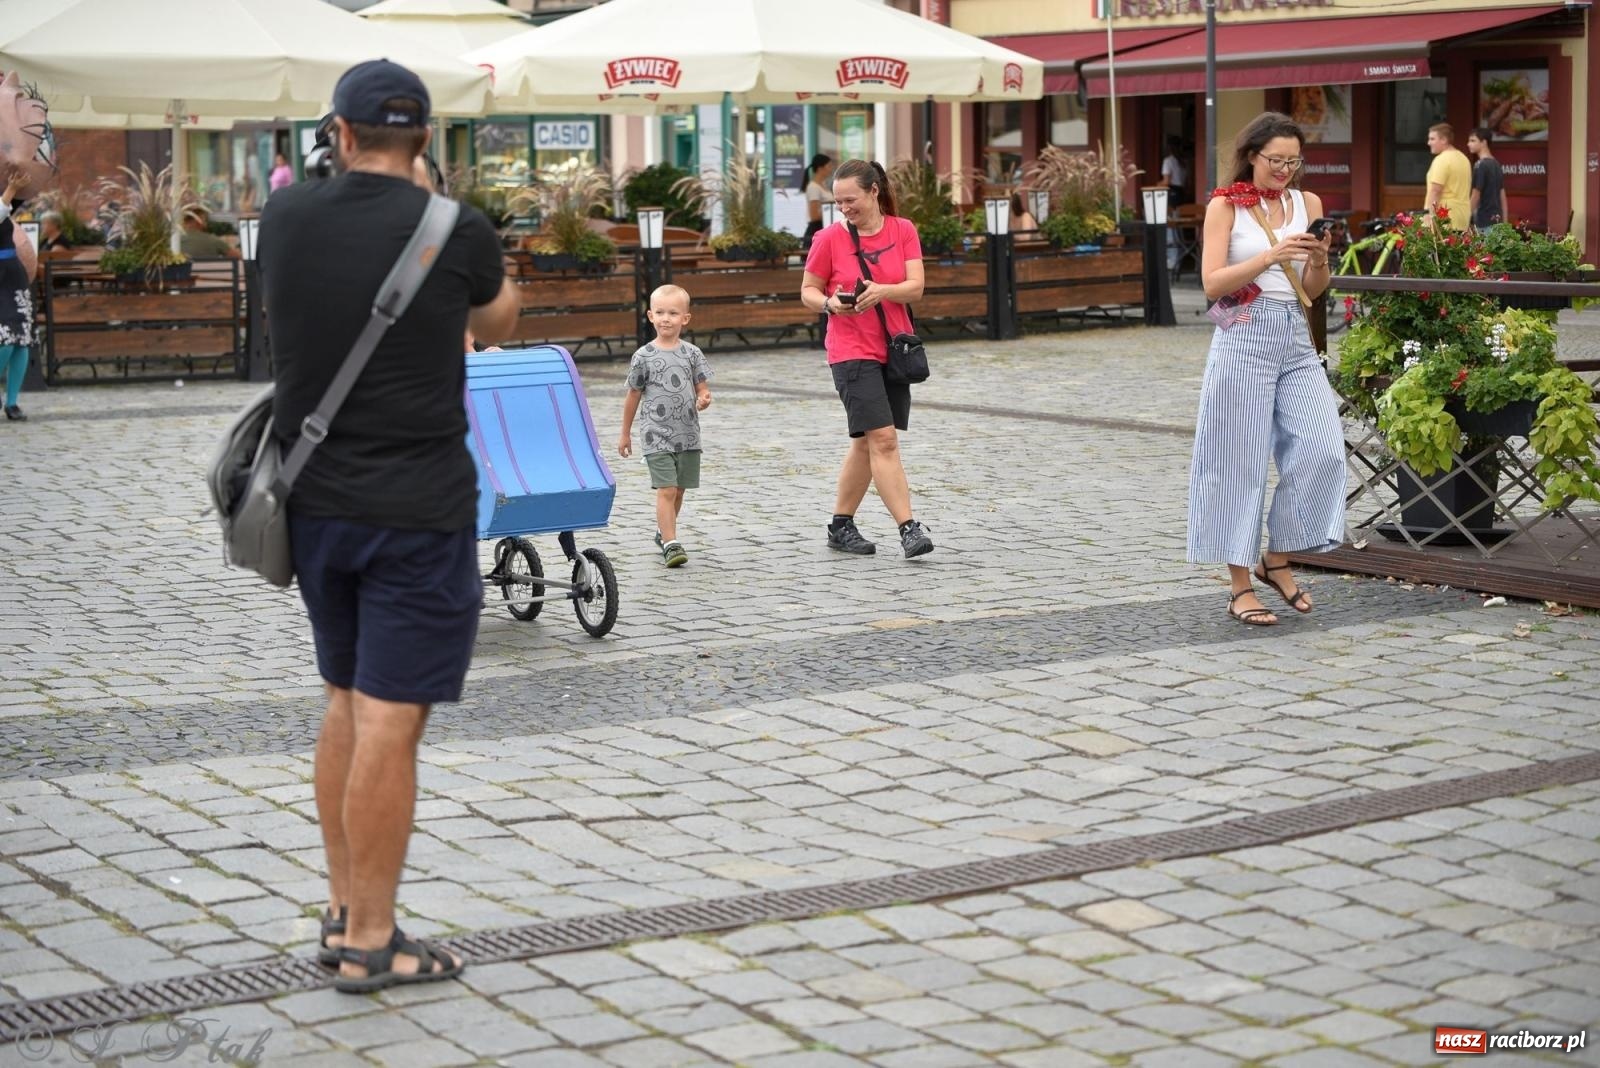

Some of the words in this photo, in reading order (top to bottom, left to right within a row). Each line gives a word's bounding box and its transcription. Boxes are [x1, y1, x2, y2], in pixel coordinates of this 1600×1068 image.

[613, 58, 675, 80] ŻYWIEC
[845, 58, 903, 80] ŻYWIEC
[538, 124, 590, 145] CASIO
[1518, 163, 1546, 175] ŚWIATA
